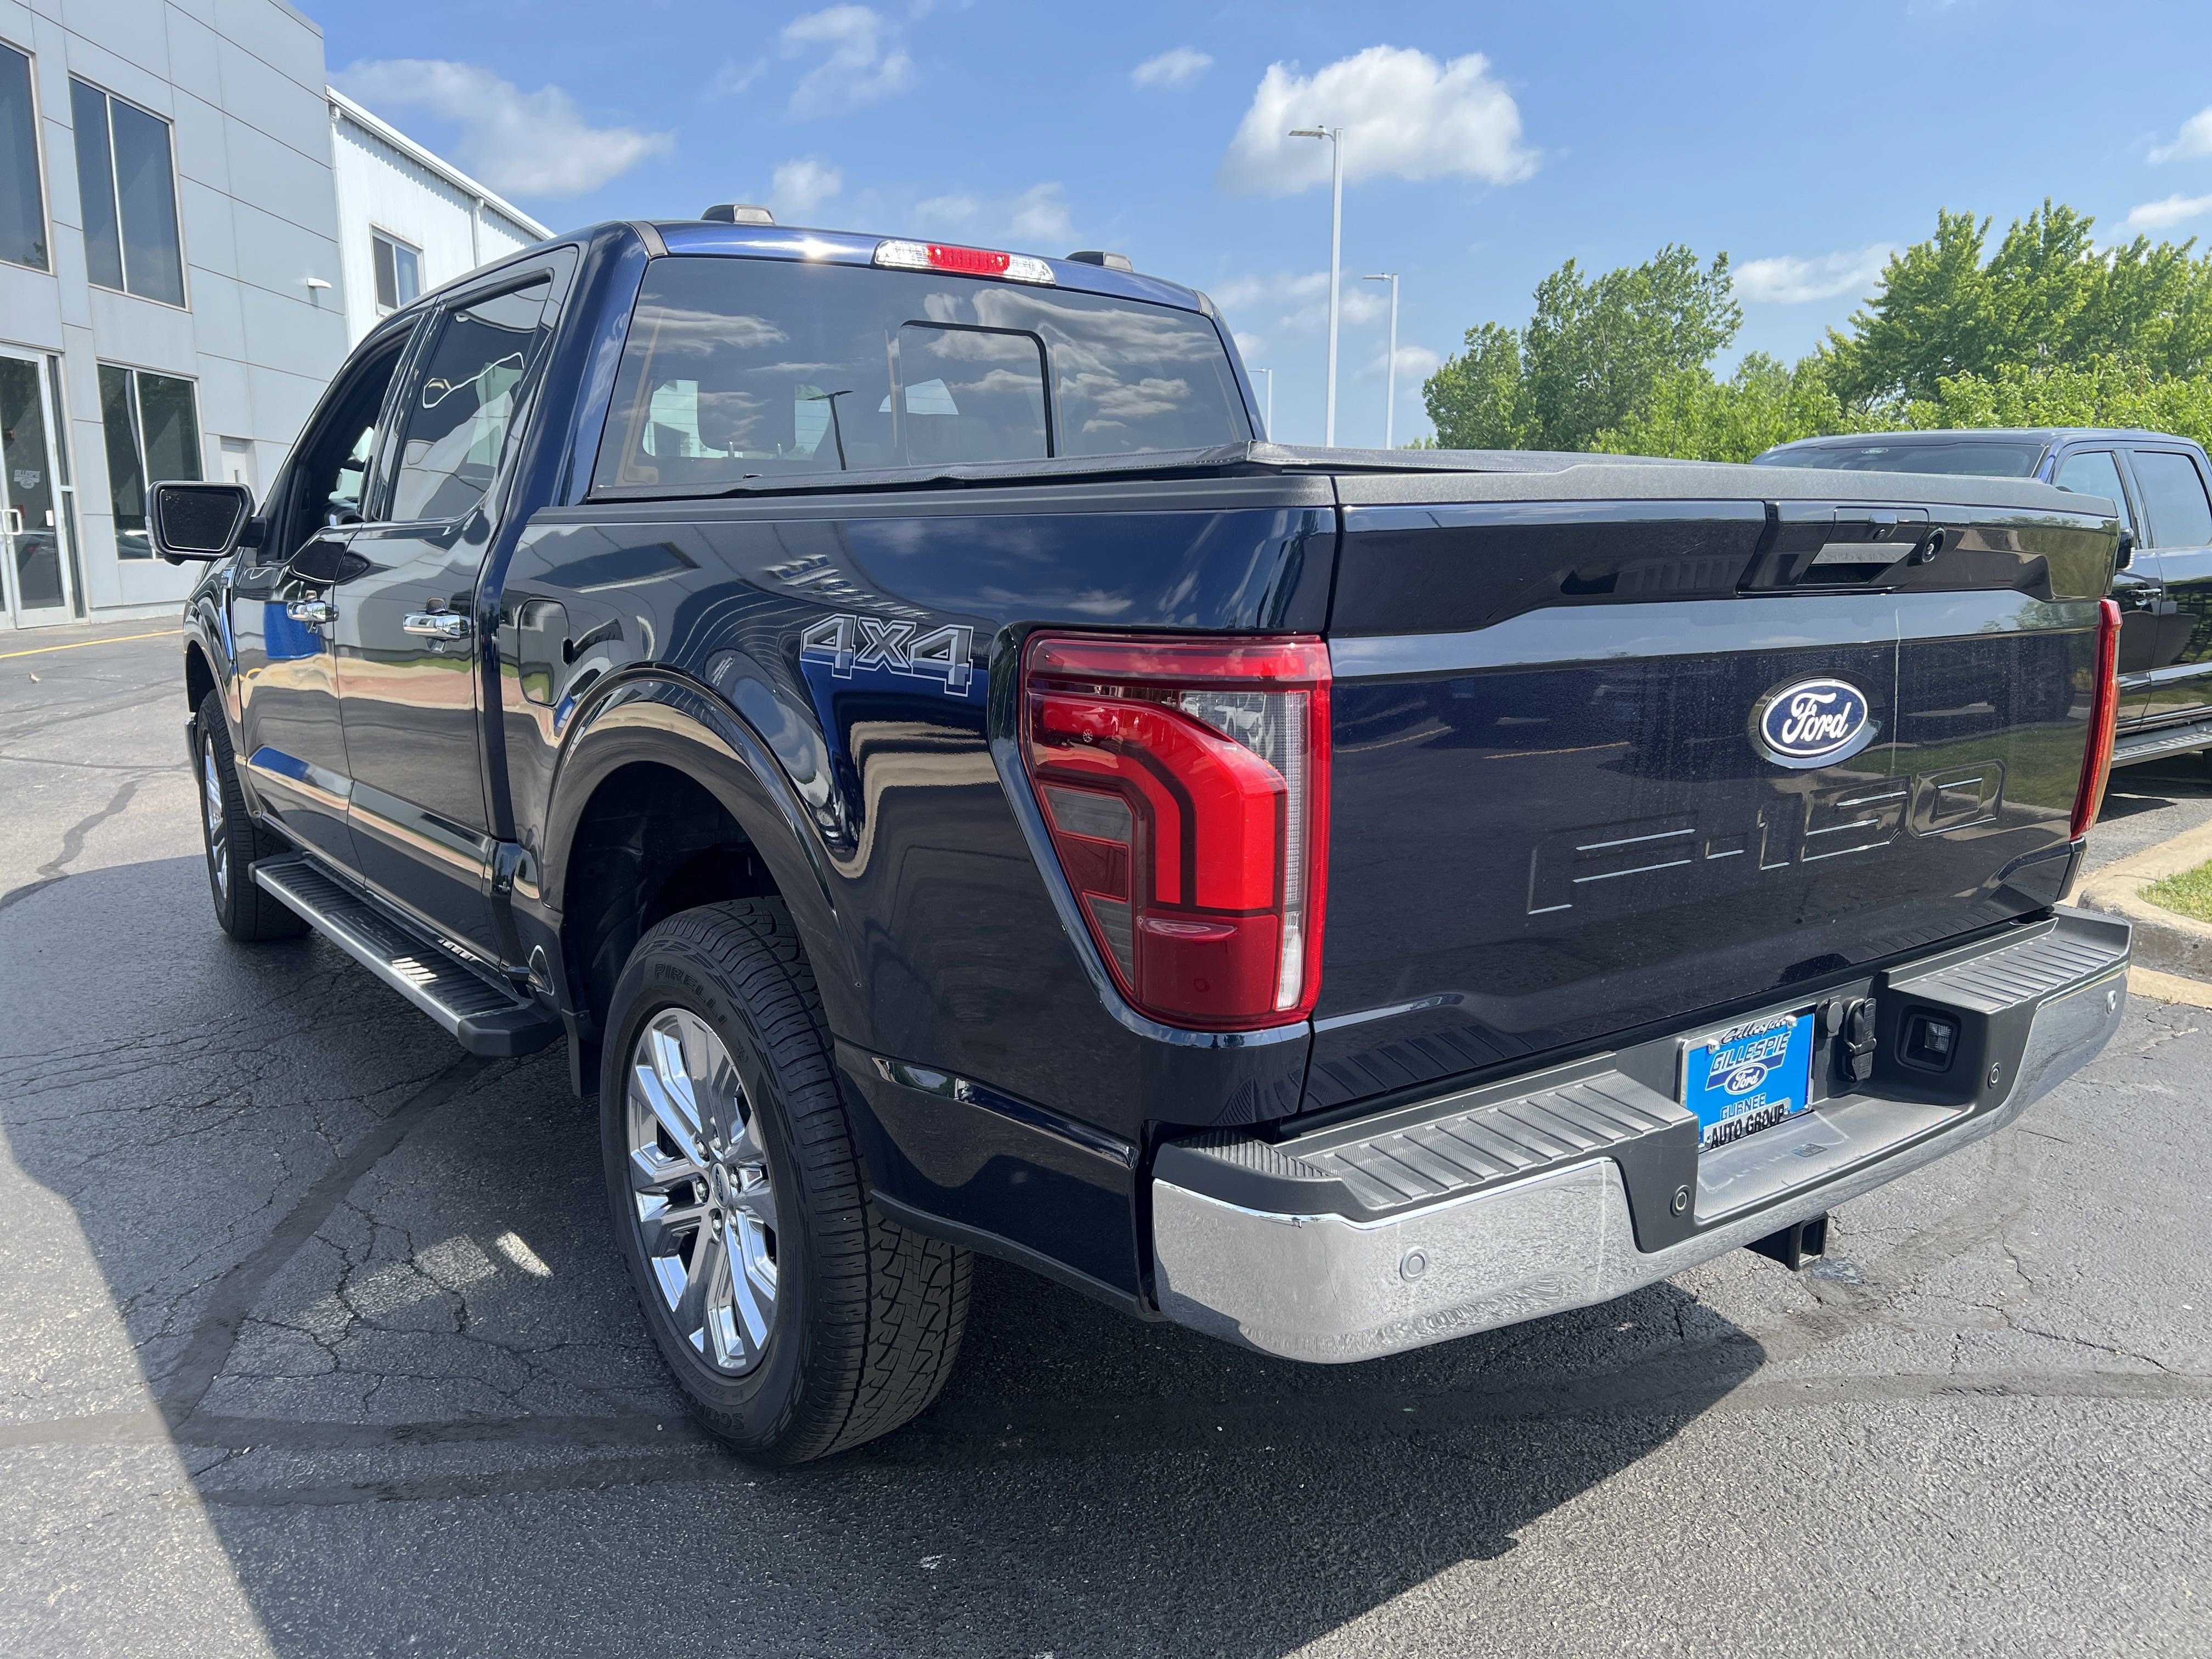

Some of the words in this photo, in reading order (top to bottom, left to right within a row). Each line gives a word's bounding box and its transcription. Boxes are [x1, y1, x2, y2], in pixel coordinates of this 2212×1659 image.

[1782, 692, 1852, 744] Ford
[654, 963, 727, 1025] PIRELLI
[1712, 1031, 1791, 1072] GILLESPIE
[1720, 1017, 1787, 1045] Gillespie
[1731, 1068, 1759, 1091] Ford
[1711, 1119, 1742, 1149] AUTO
[1746, 1103, 1785, 1135] GROUP
[1720, 1092, 1766, 1121] GURNEE
